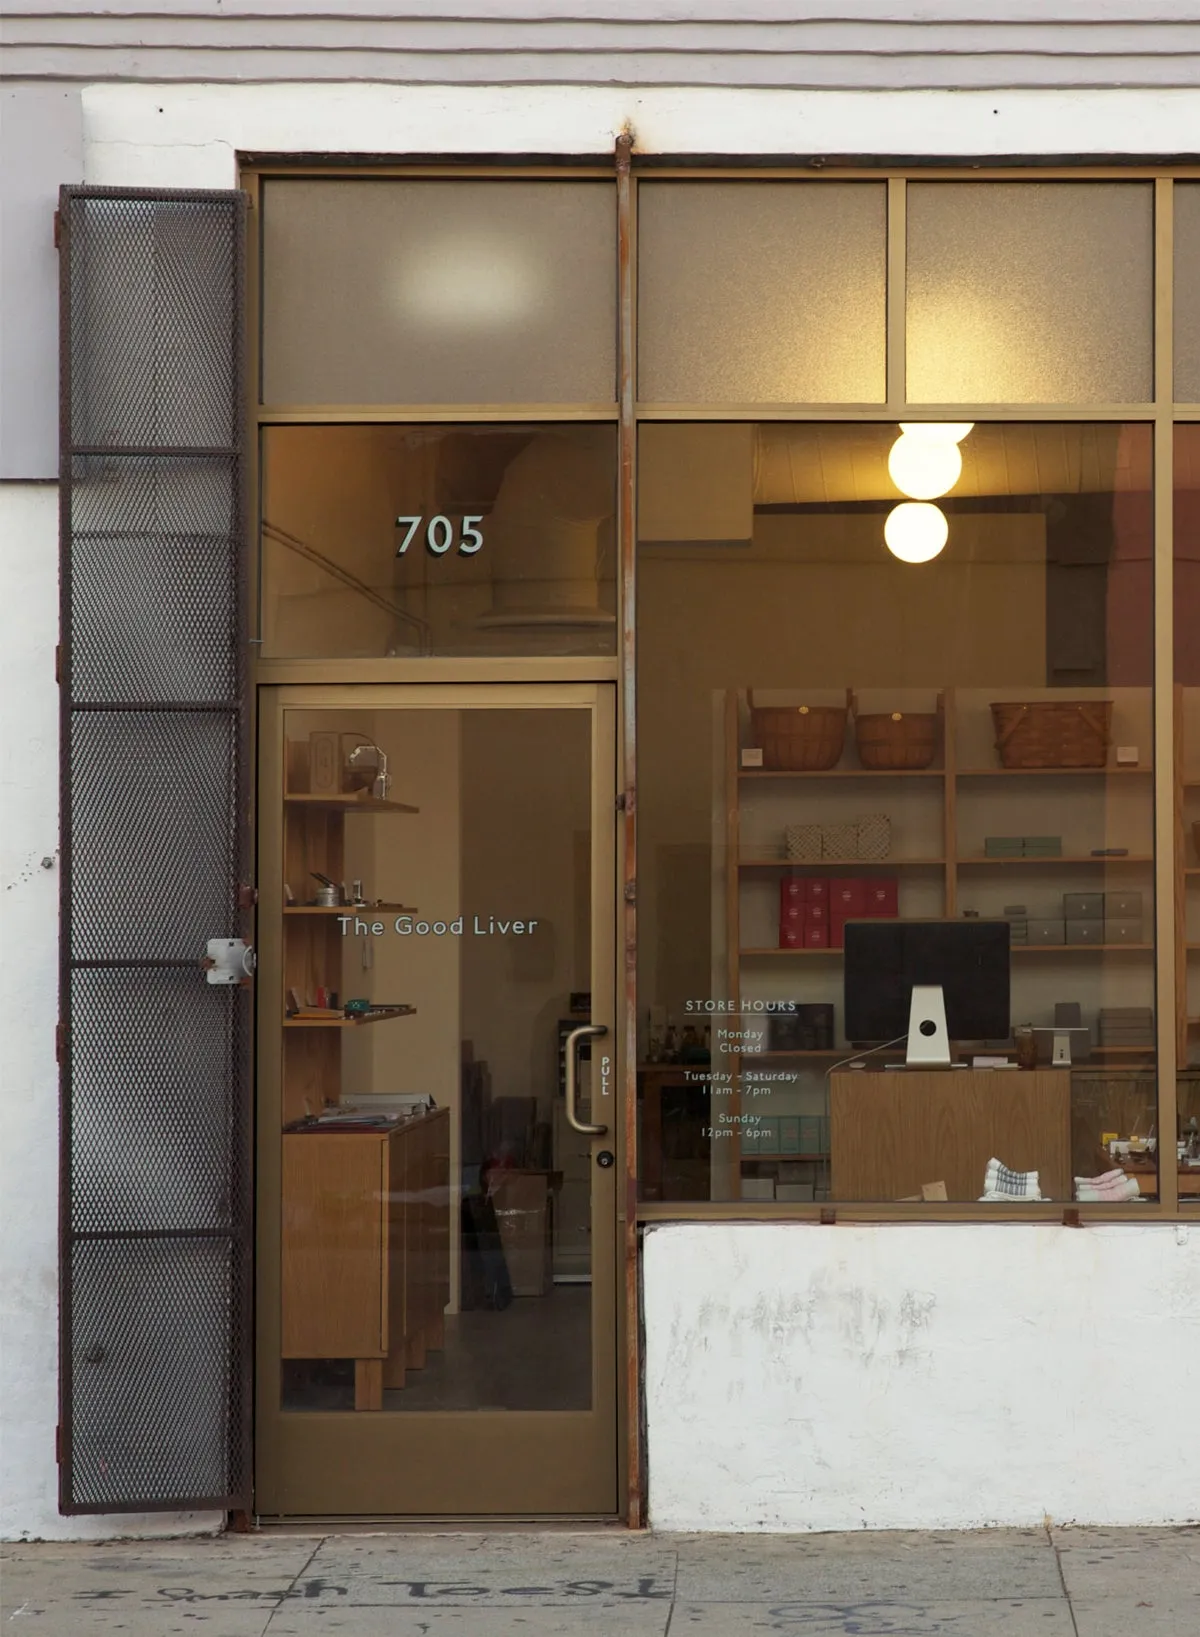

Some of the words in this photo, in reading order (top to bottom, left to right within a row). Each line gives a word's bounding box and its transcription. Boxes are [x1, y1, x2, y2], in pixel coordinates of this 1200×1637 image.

[398, 515, 484, 553] 705
[337, 917, 384, 936] The
[394, 916, 464, 936] Good
[473, 916, 538, 935] Liver
[685, 1000, 735, 1011] STORE
[741, 1000, 796, 1011] HOURS
[717, 1029, 763, 1041] Monday
[719, 1043, 762, 1053] Closed
[601, 1056, 610, 1096] PULL
[684, 1071, 732, 1083] Tuesday
[746, 1071, 798, 1083] Saturday
[702, 1085, 733, 1095] 11am
[746, 1085, 771, 1097] 7pm
[718, 1113, 762, 1125] Sunday
[701, 1127, 733, 1139] 12pm
[746, 1127, 771, 1139] 6pm
